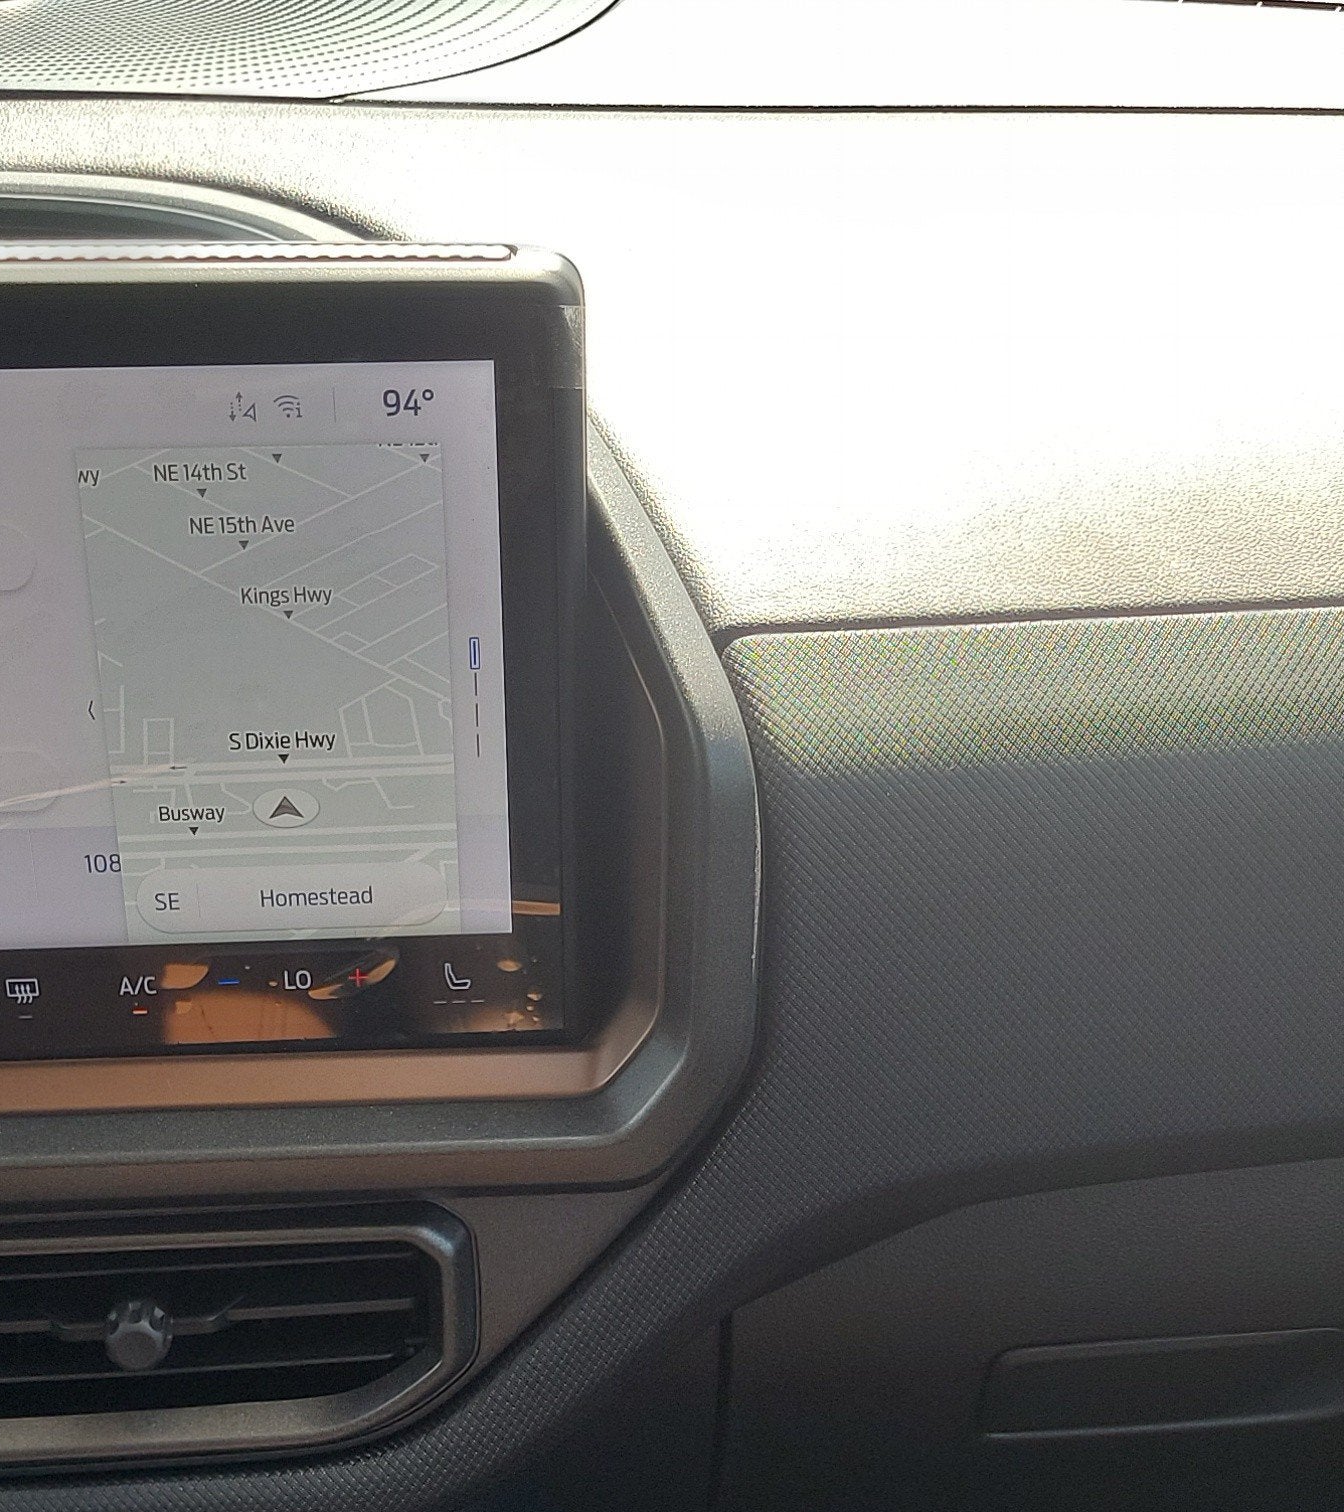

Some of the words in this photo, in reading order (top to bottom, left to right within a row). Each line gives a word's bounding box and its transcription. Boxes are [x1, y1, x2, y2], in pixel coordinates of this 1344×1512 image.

[382, 388, 435, 417] 94°
[154, 464, 178, 483] NE
[183, 463, 222, 482] 14th
[226, 463, 247, 481] St
[189, 516, 214, 535] NE
[219, 516, 257, 534] 15th
[261, 515, 295, 533] Ave
[241, 587, 289, 607] Kings
[293, 586, 332, 606] Hwy
[228, 732, 241, 751] S
[246, 731, 291, 750] Dixie
[296, 730, 336, 751] Hwy
[158, 805, 225, 823] Busway
[83, 853, 122, 874] 108
[154, 891, 180, 911] SE
[260, 885, 373, 908] Homestead
[119, 975, 157, 997] A/C
[283, 969, 312, 991] LO
